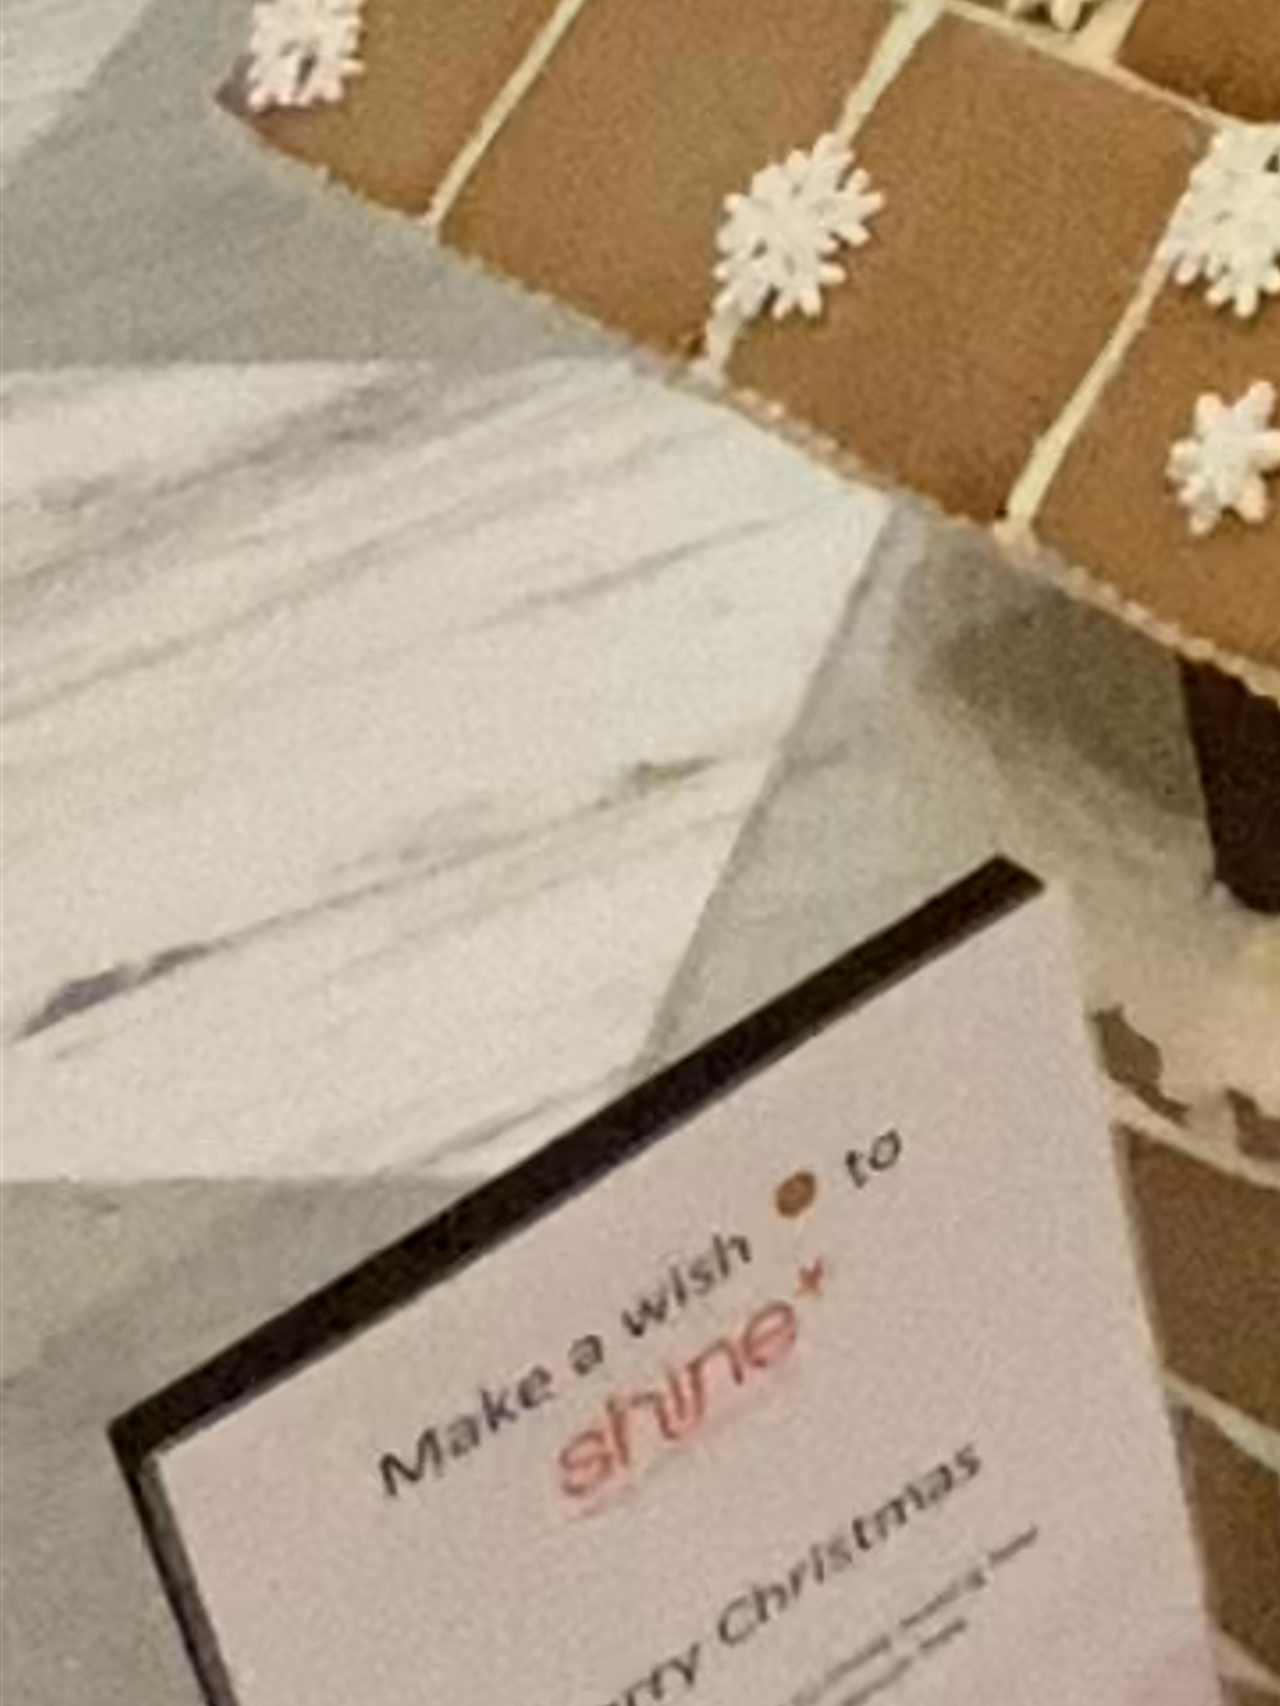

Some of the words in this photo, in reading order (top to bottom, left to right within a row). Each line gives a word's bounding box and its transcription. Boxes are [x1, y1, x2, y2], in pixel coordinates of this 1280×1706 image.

[377, 1364, 555, 1498] Make
[566, 1331, 605, 1378] a
[620, 1230, 754, 1340] wish
[844, 1128, 903, 1189] to
[716, 1440, 983, 1648] Christmas
